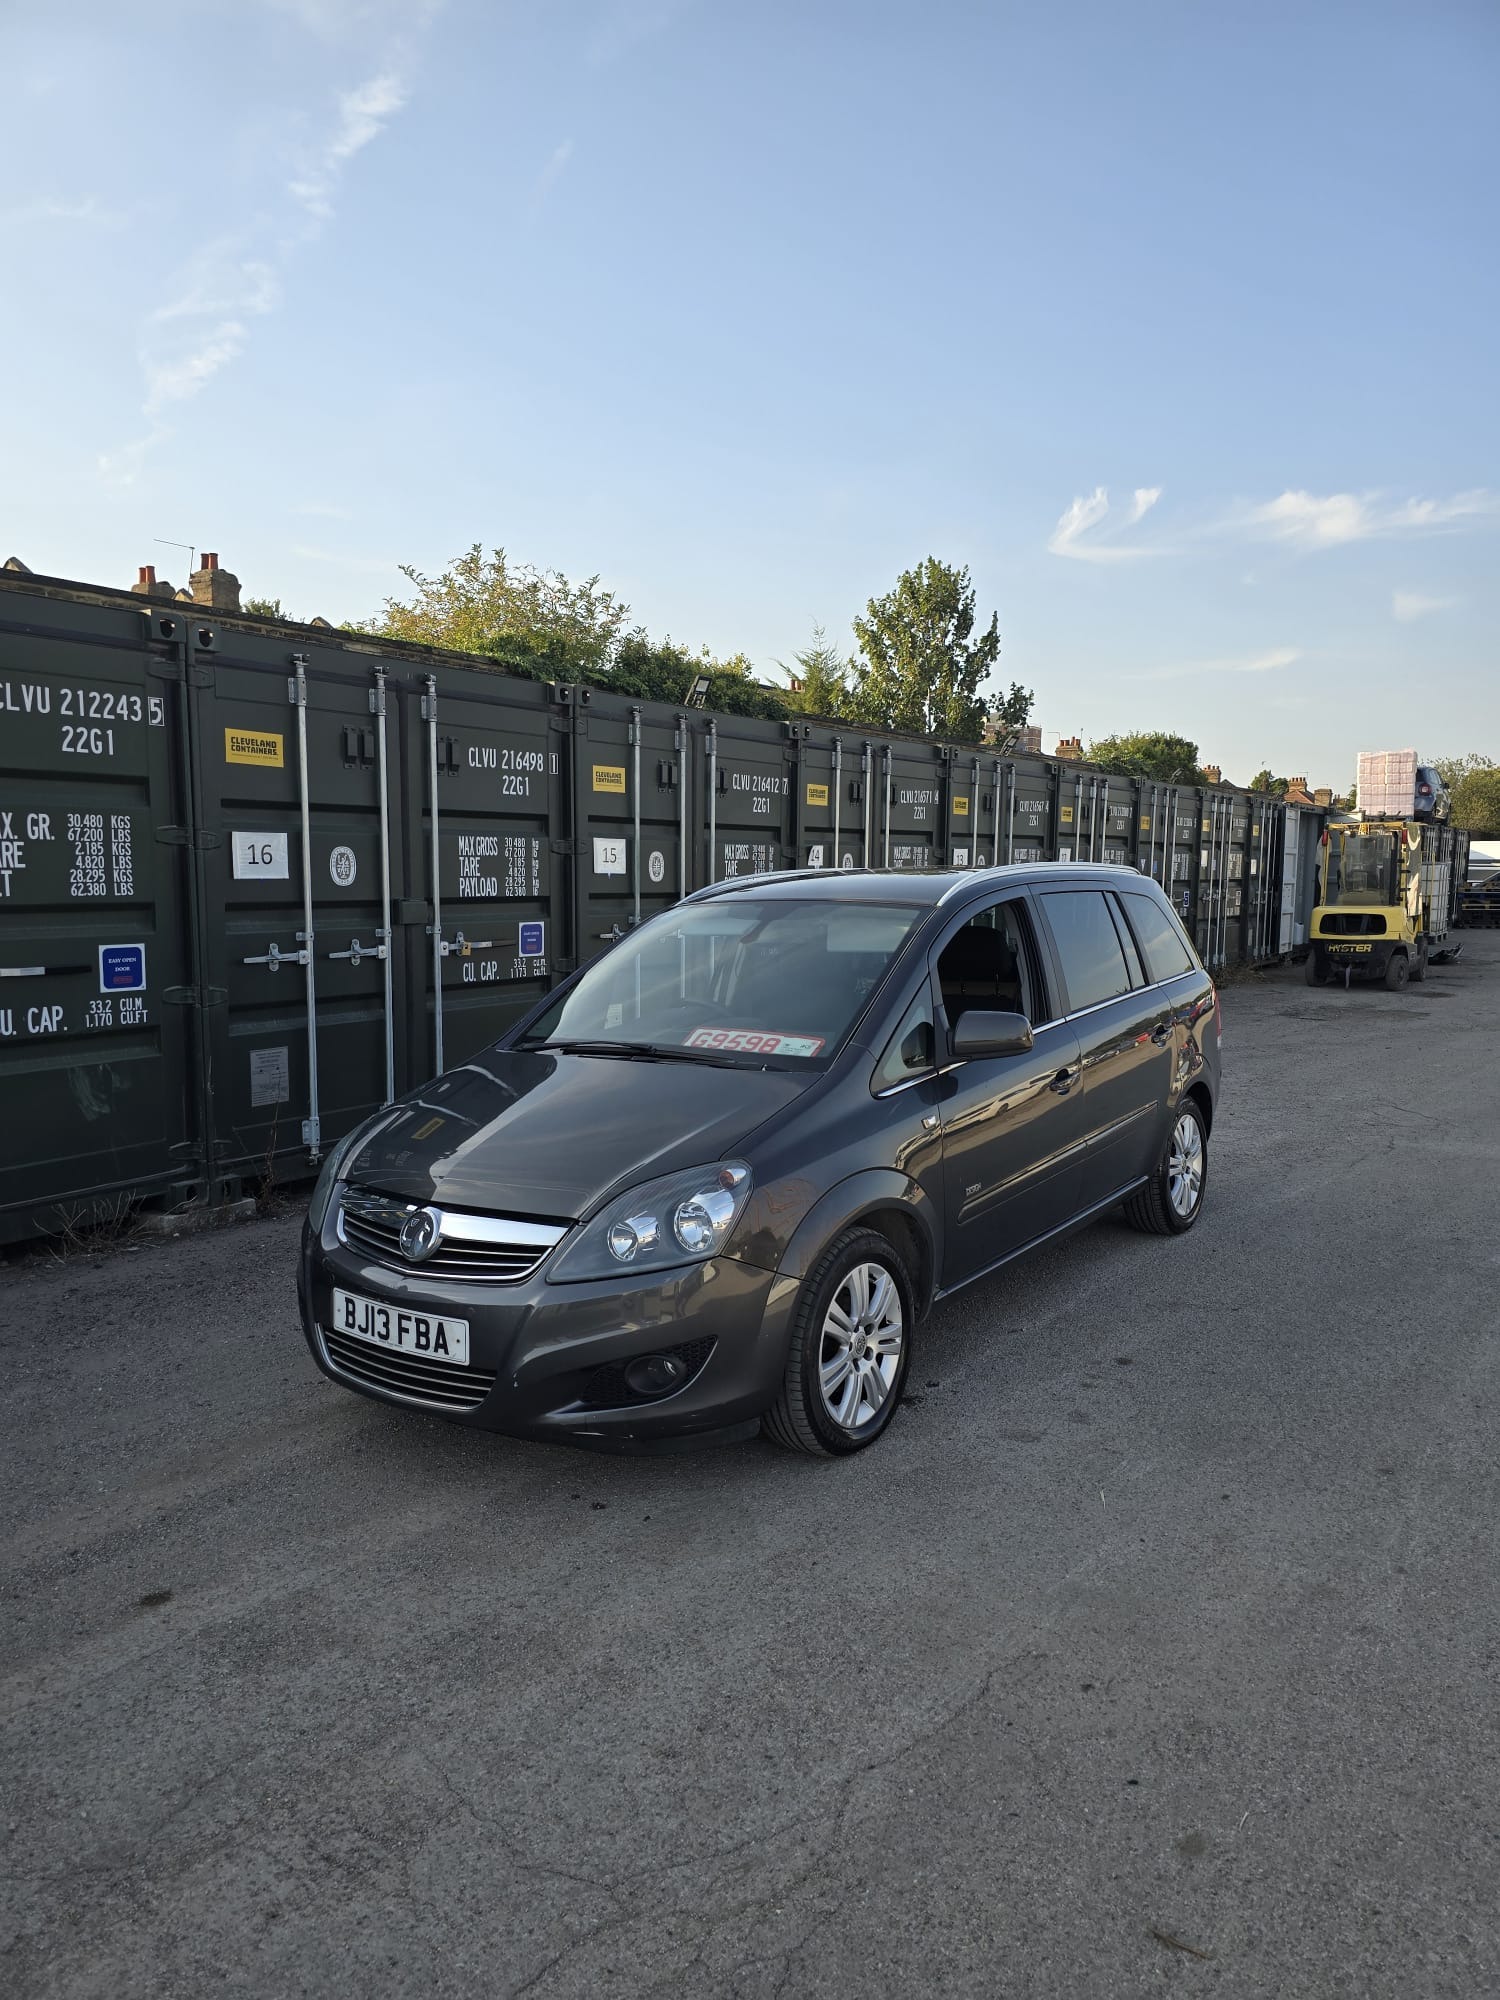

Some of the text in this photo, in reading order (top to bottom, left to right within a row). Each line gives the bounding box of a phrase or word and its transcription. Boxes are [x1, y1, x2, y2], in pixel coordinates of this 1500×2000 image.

[60, 688, 143, 722] 212243
[149, 699, 163, 725] 5
[61, 725, 114, 756] 22G1
[230, 736, 277, 748] CLEVELAND
[468, 747, 497, 768] CLVU
[501, 750, 544, 772] 216498
[502, 775, 530, 796] 22G1
[732, 773, 751, 791] CLVU
[752, 775, 779, 793] 216412
[752, 797, 770, 814] 22G1
[0, 812, 55, 841] X. GR.
[111, 815, 131, 829] KGS
[111, 829, 131, 842] LBS
[458, 835, 498, 856] MAX GROSS
[0, 841, 26, 868] RE
[112, 842, 132, 856] KGS
[247, 844, 273, 865] 16
[602, 847, 617, 864] 15
[112, 856, 133, 869] LBS
[458, 856, 481, 877] TARE
[113, 869, 133, 883] KGS
[114, 883, 134, 896] LBS
[459, 877, 498, 897] PAYLOAD
[1328, 943, 1373, 953] HYSTER
[462, 960, 500, 982] CU. CAP.
[89, 997, 143, 1014] 33.2 CU.M
[27, 1005, 68, 1034] CAP.
[120, 1009, 148, 1025] CU.FT
[691, 1032, 781, 1054] G9598
[344, 1296, 450, 1356] BJ13 FBA
